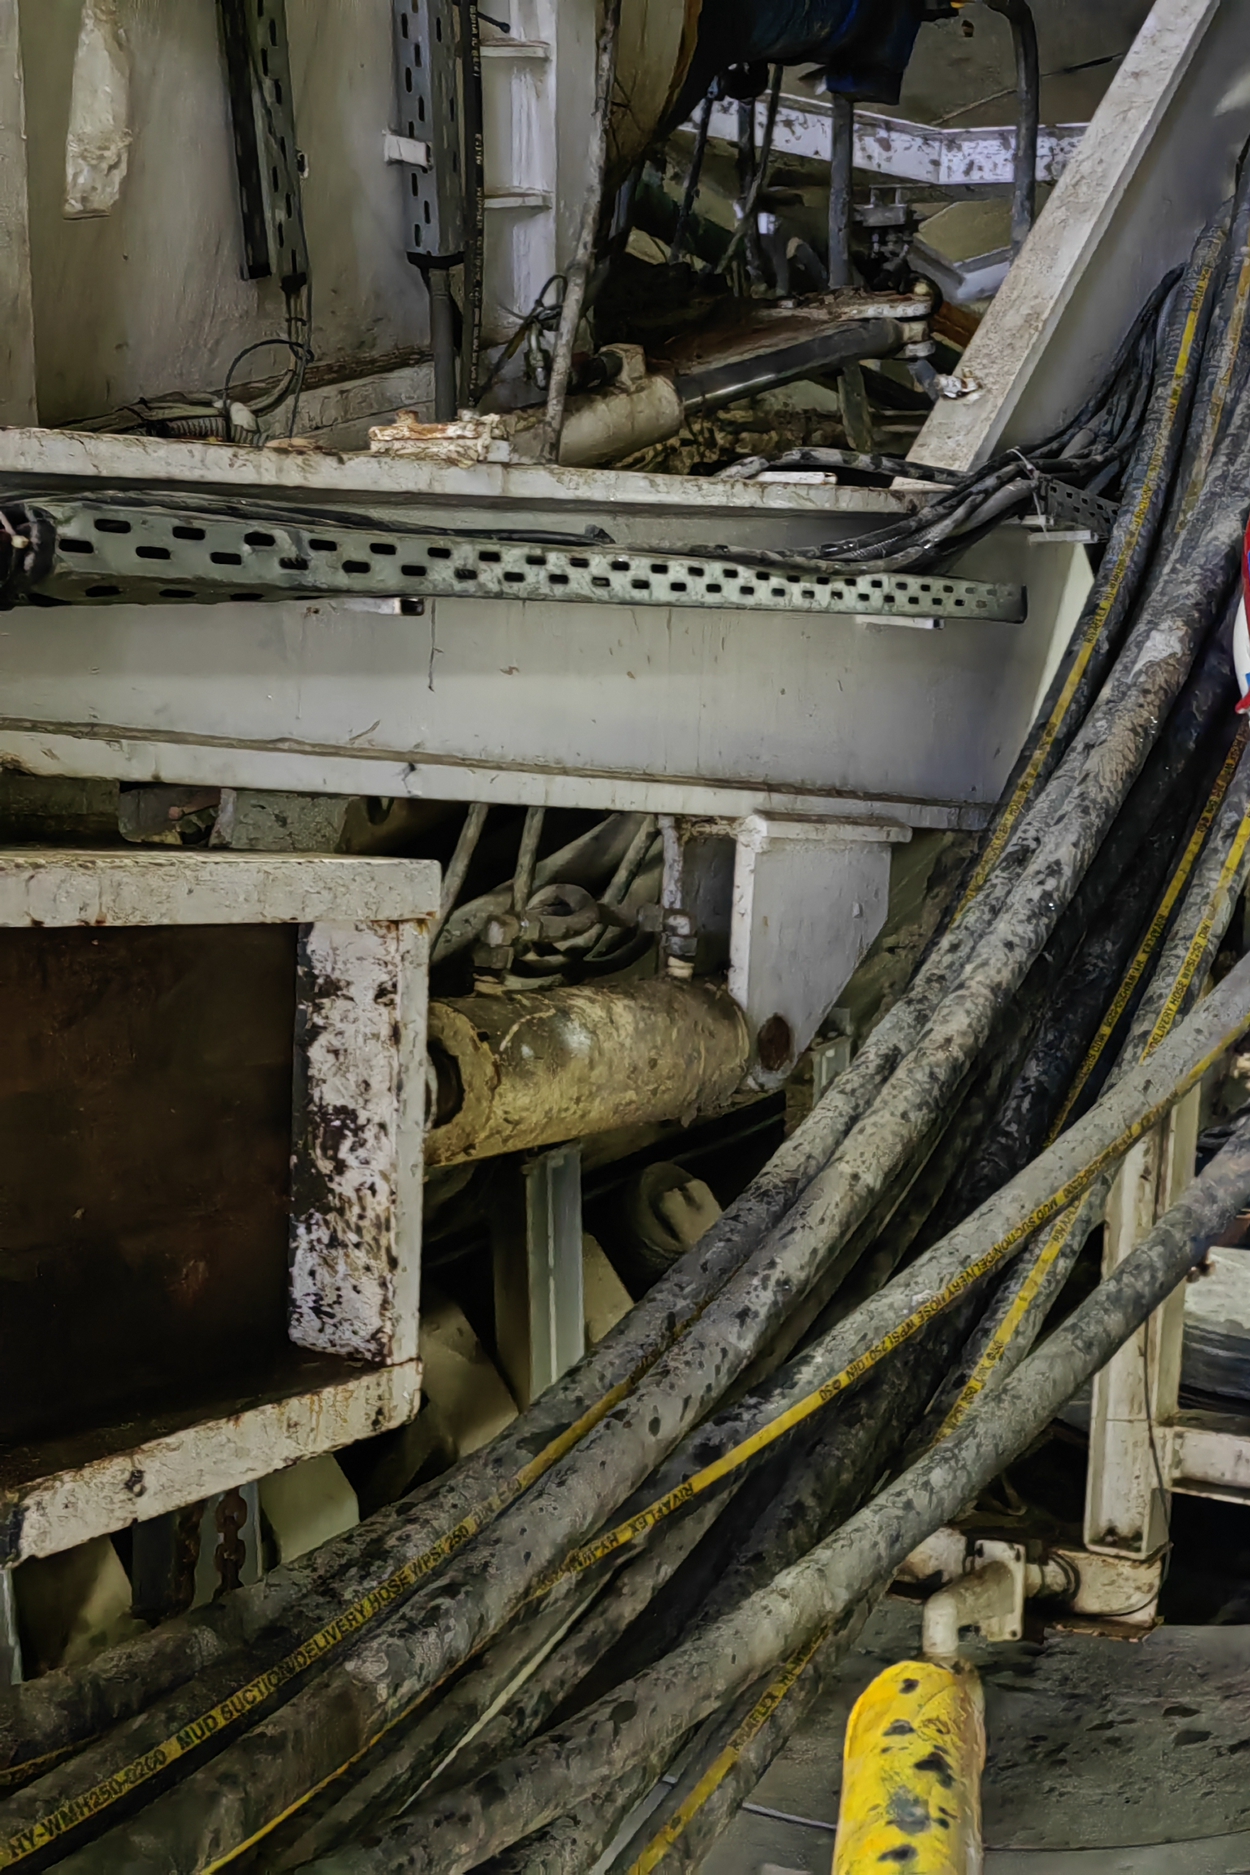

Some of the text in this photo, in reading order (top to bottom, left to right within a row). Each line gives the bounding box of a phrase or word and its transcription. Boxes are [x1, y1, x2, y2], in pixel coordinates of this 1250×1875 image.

[1033, 1196, 1059, 1221] MUD
[626, 1482, 696, 1535] RIVAFLEX
[172, 1711, 220, 1751] MUD
[366, 1569, 413, 1612] HOSE
